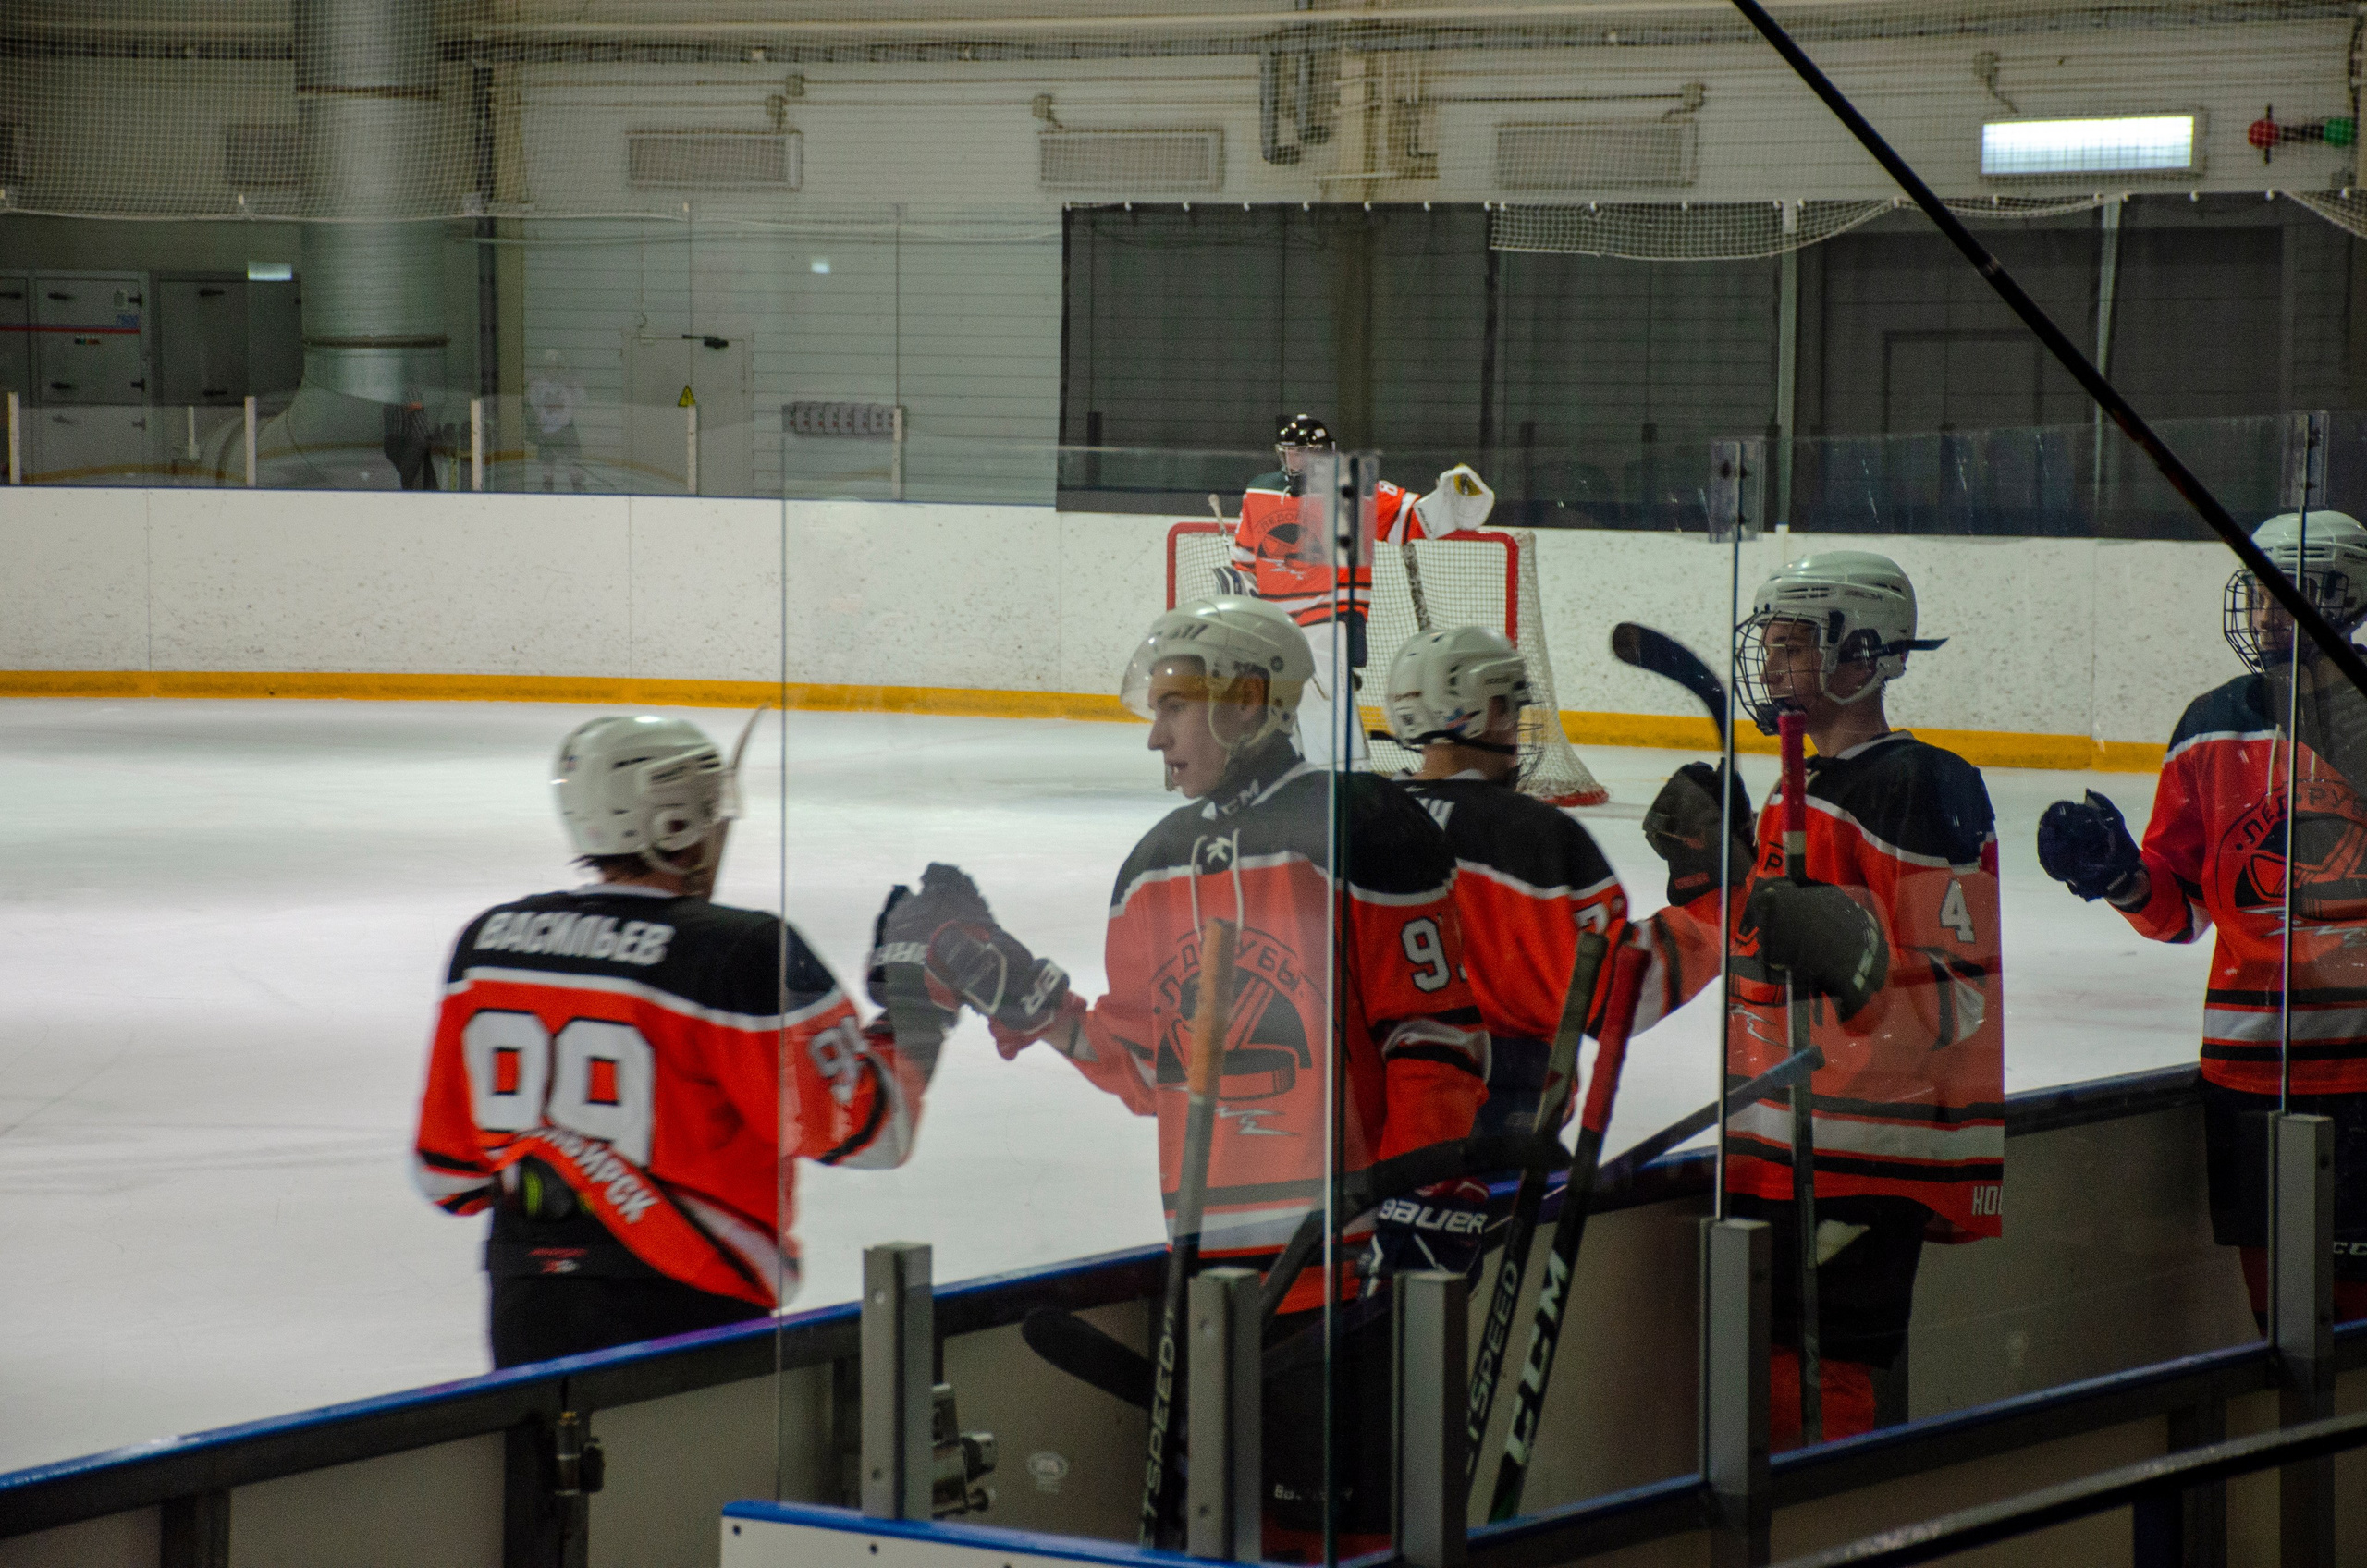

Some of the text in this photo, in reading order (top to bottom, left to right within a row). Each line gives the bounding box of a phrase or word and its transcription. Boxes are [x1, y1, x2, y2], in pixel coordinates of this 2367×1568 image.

[472, 911, 676, 966] ВАСИЛЬЕВ
[1939, 877, 1977, 944] 4
[1399, 911, 1468, 993] 9
[1505, 1249, 1569, 1467] CCM
